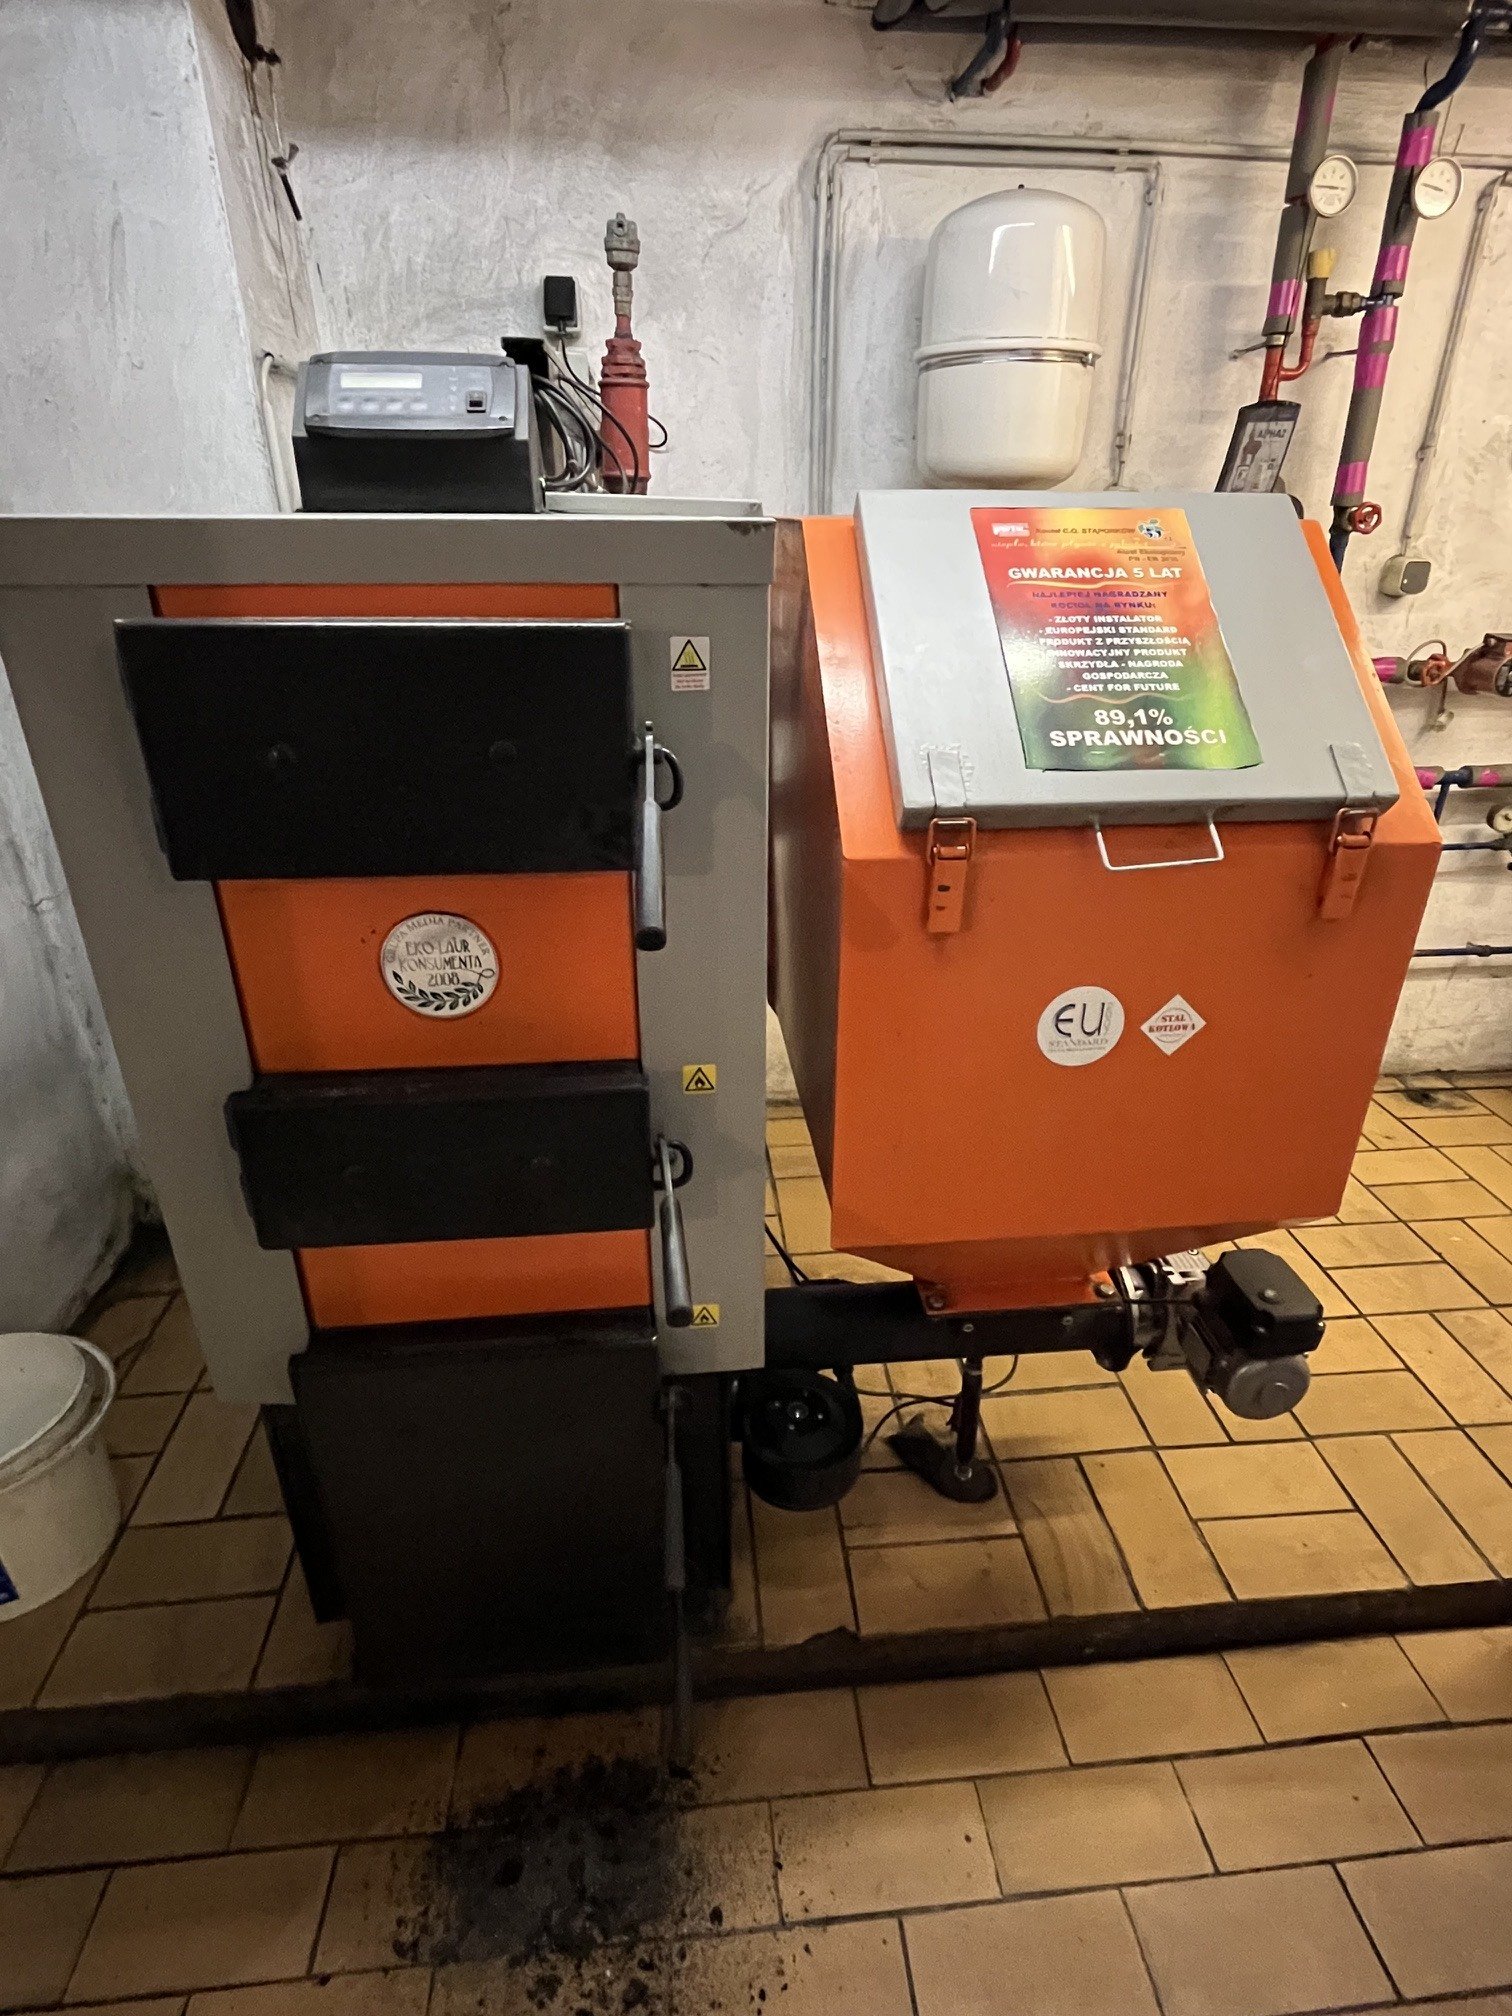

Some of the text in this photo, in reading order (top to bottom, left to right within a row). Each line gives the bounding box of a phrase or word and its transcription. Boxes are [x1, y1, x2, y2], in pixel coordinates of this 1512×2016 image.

[1008, 567, 1182, 579] GWARANCJA 5 LAT
[1054, 615, 1091, 624] ZŁOTY
[1093, 615, 1164, 623] INSTALATOR
[1044, 626, 1117, 635] EUROPEJSKI
[1118, 626, 1178, 634] STANDARD
[1039, 636, 1191, 646] PRODUKT Z PRZYSZŁOŚCIĄ
[1133, 648, 1188, 656] PRODUKT
[1057, 660, 1120, 669] SKRZYDŁA
[1127, 660, 1184, 668] NAGRODA
[1081, 672, 1169, 680] GOSPODARCZA
[1073, 683, 1105, 692] CENT
[1107, 683, 1132, 692] FOR
[1133, 683, 1181, 692] FUTURE
[1094, 708, 1174, 728] 89,1%
[1049, 726, 1227, 747] SPRAWNOŚCI
[406, 916, 444, 933] MEDIA
[448, 917, 491, 956] PARTNER
[405, 936, 471, 956] EKO LAUR
[397, 956, 483, 973] KONSUMENTA
[427, 972, 461, 987] 2008
[1053, 1002, 1106, 1038] EU
[1161, 1014, 1186, 1023] STAL
[1048, 1038, 1109, 1048] STANDARD
